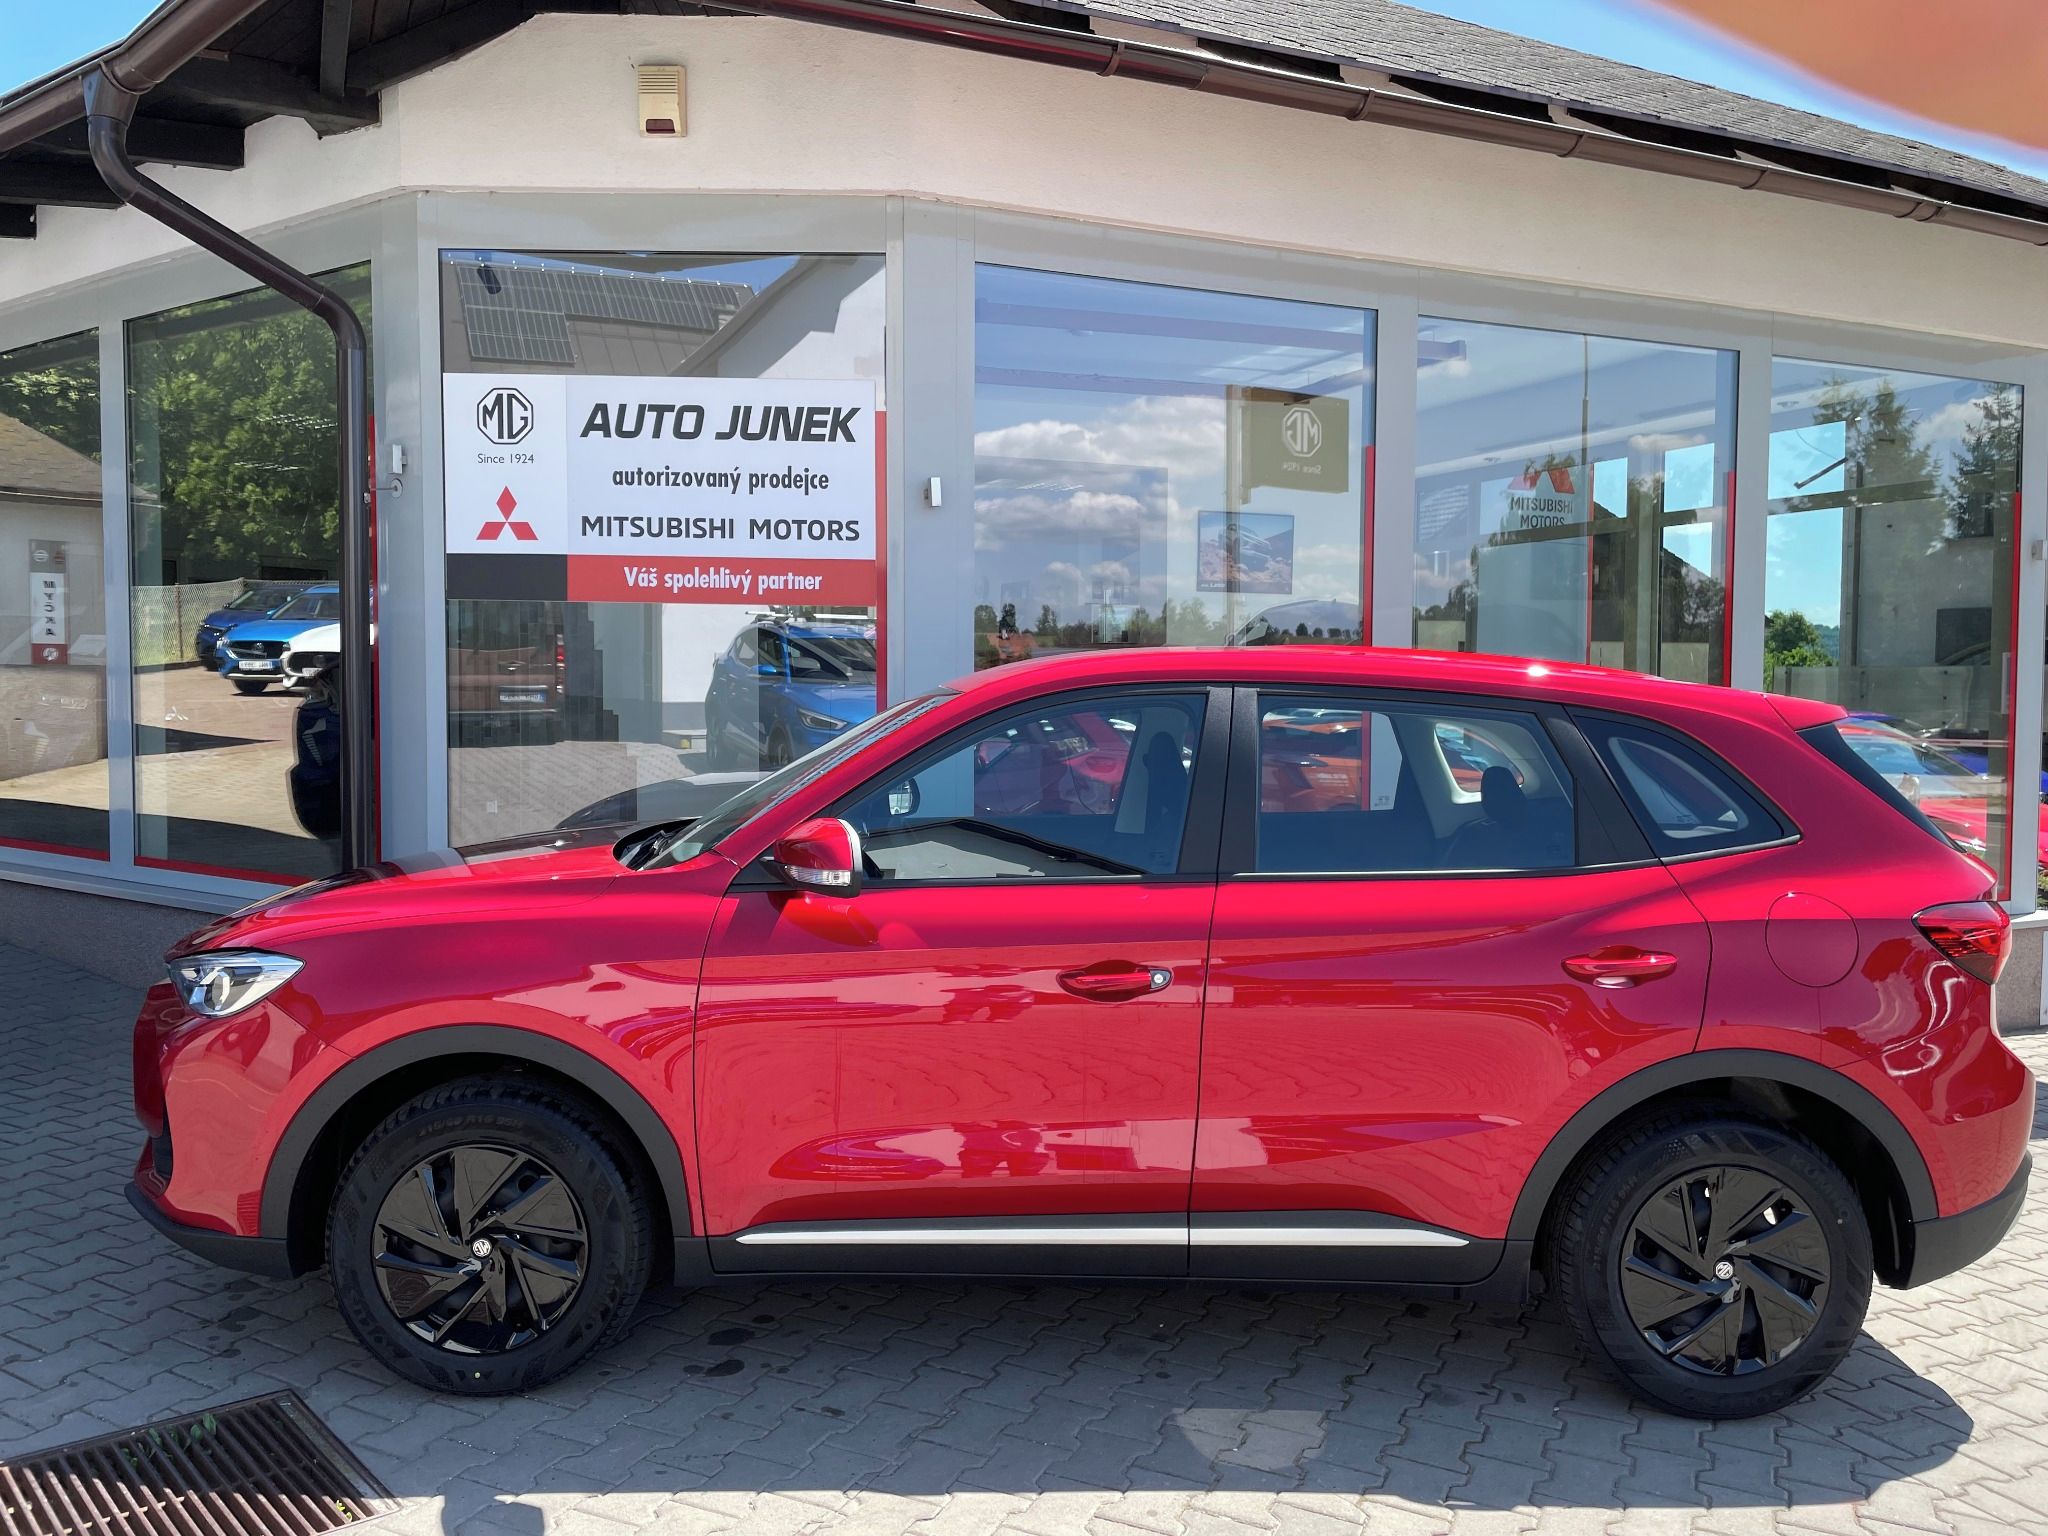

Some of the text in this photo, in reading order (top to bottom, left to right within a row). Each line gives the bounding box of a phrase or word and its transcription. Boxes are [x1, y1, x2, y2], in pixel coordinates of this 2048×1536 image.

[481, 391, 530, 441] MG
[580, 403, 861, 443] AUTO JUNEK
[477, 453, 535, 464] Since 1924
[612, 464, 829, 496] autorizovaný prodejce
[1510, 496, 1573, 514] MITSUBISHI
[581, 515, 860, 542] MITSUBISHI MOTORS
[623, 566, 823, 595] Váš spolehlivý partner
